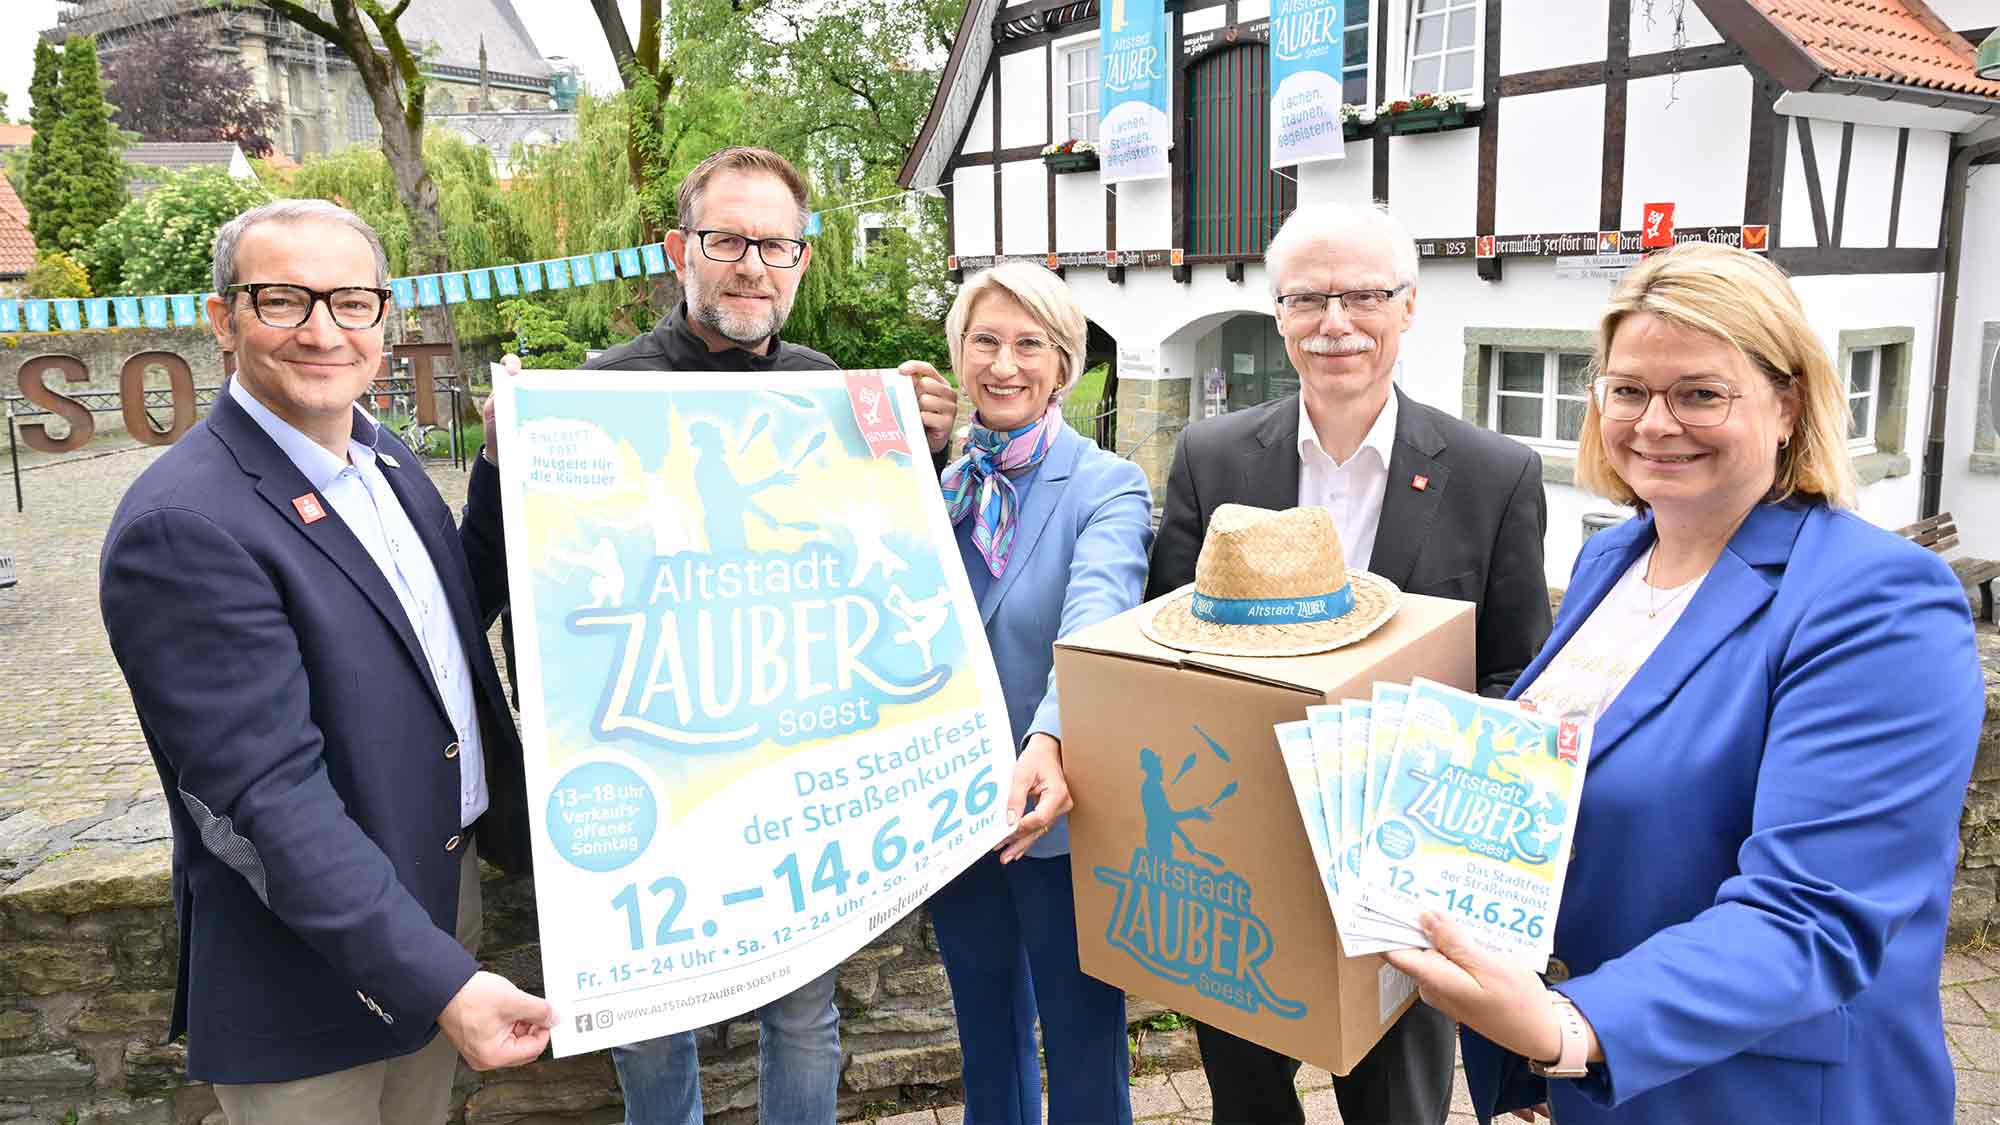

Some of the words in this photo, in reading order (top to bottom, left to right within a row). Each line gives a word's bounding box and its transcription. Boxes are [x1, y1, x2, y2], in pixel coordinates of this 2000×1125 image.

[1271, 5, 1340, 60] ZAUBER
[1104, 47, 1161, 93] ZAUBER
[1281, 89, 1323, 111] Lachen.
[1496, 233, 1542, 255] vermutlich
[1583, 234, 1597, 251] im
[530, 470, 552, 483] die
[556, 471, 617, 486] Künstler
[532, 455, 588, 472] Hutgeld
[592, 456, 613, 471] für
[649, 552, 841, 604] Altstadt
[1248, 606, 1295, 617] Altstadt
[1295, 600, 1329, 617] ZAUBER
[576, 595, 946, 744] ZAUBER
[777, 697, 872, 737] Soest
[795, 767, 850, 798] Das
[856, 711, 988, 780] Stadtfest
[744, 816, 795, 846] der
[803, 738, 994, 833] Straßenkunst
[1443, 767, 1524, 802] Altstadt
[562, 806, 640, 825] Verkaufs-
[1409, 769, 1547, 864] ZAUBER
[571, 837, 640, 857] Sonntag
[1469, 840, 1511, 860] Soest
[1135, 855, 1249, 911] Altstadt
[1441, 870, 1461, 884] der
[1463, 876, 1549, 911] Straßenkunst
[1467, 862, 1490, 879] Das
[1492, 870, 1551, 896] Stadtfest
[576, 970, 603, 991] Fr.
[681, 948, 717, 970] Uhr
[736, 939, 767, 958] Sa.
[836, 894, 867, 919] Uhr
[883, 874, 908, 893] So.
[969, 811, 999, 837] Uhr
[1097, 868, 1303, 1012] ZAUBER
[1200, 973, 1255, 1008] Soest
